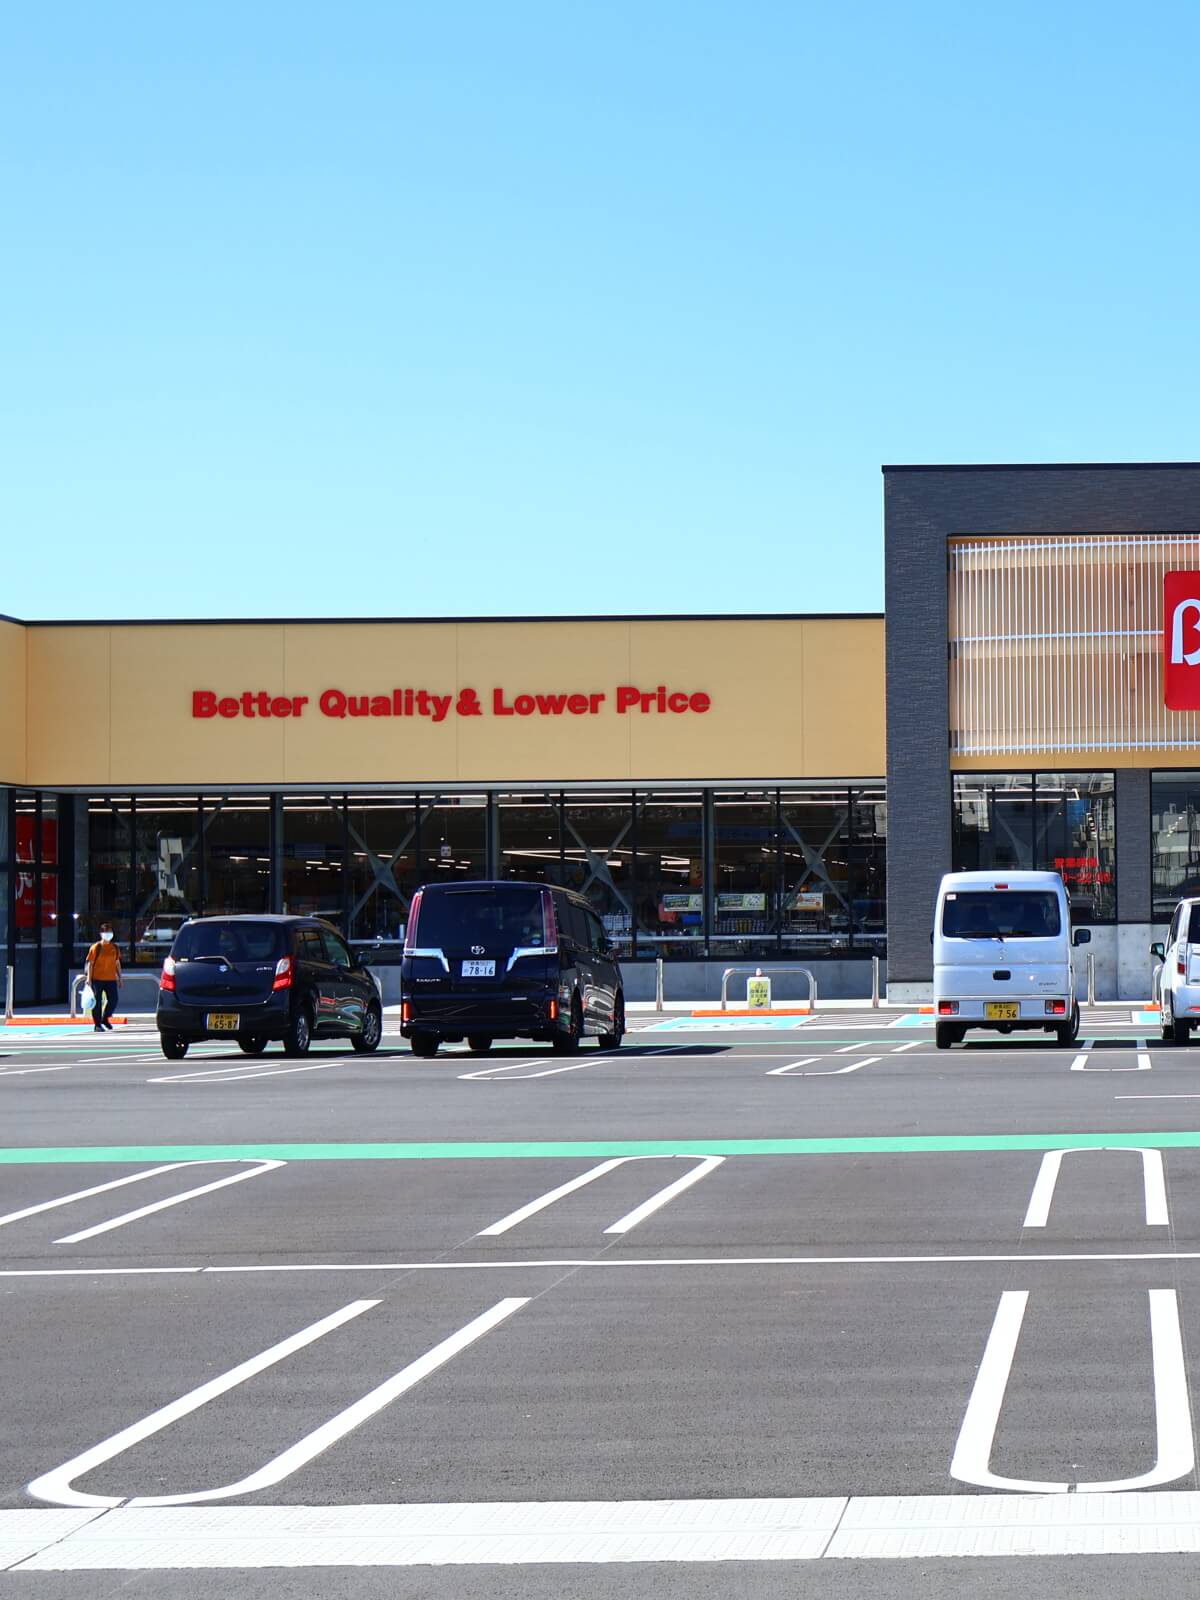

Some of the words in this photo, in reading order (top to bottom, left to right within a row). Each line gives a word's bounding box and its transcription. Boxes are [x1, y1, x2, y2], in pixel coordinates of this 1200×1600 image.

[192, 690, 309, 718] Better
[319, 689, 452, 722] Quality
[456, 688, 482, 716] &
[493, 688, 605, 716] Lower
[616, 686, 711, 714] Price
